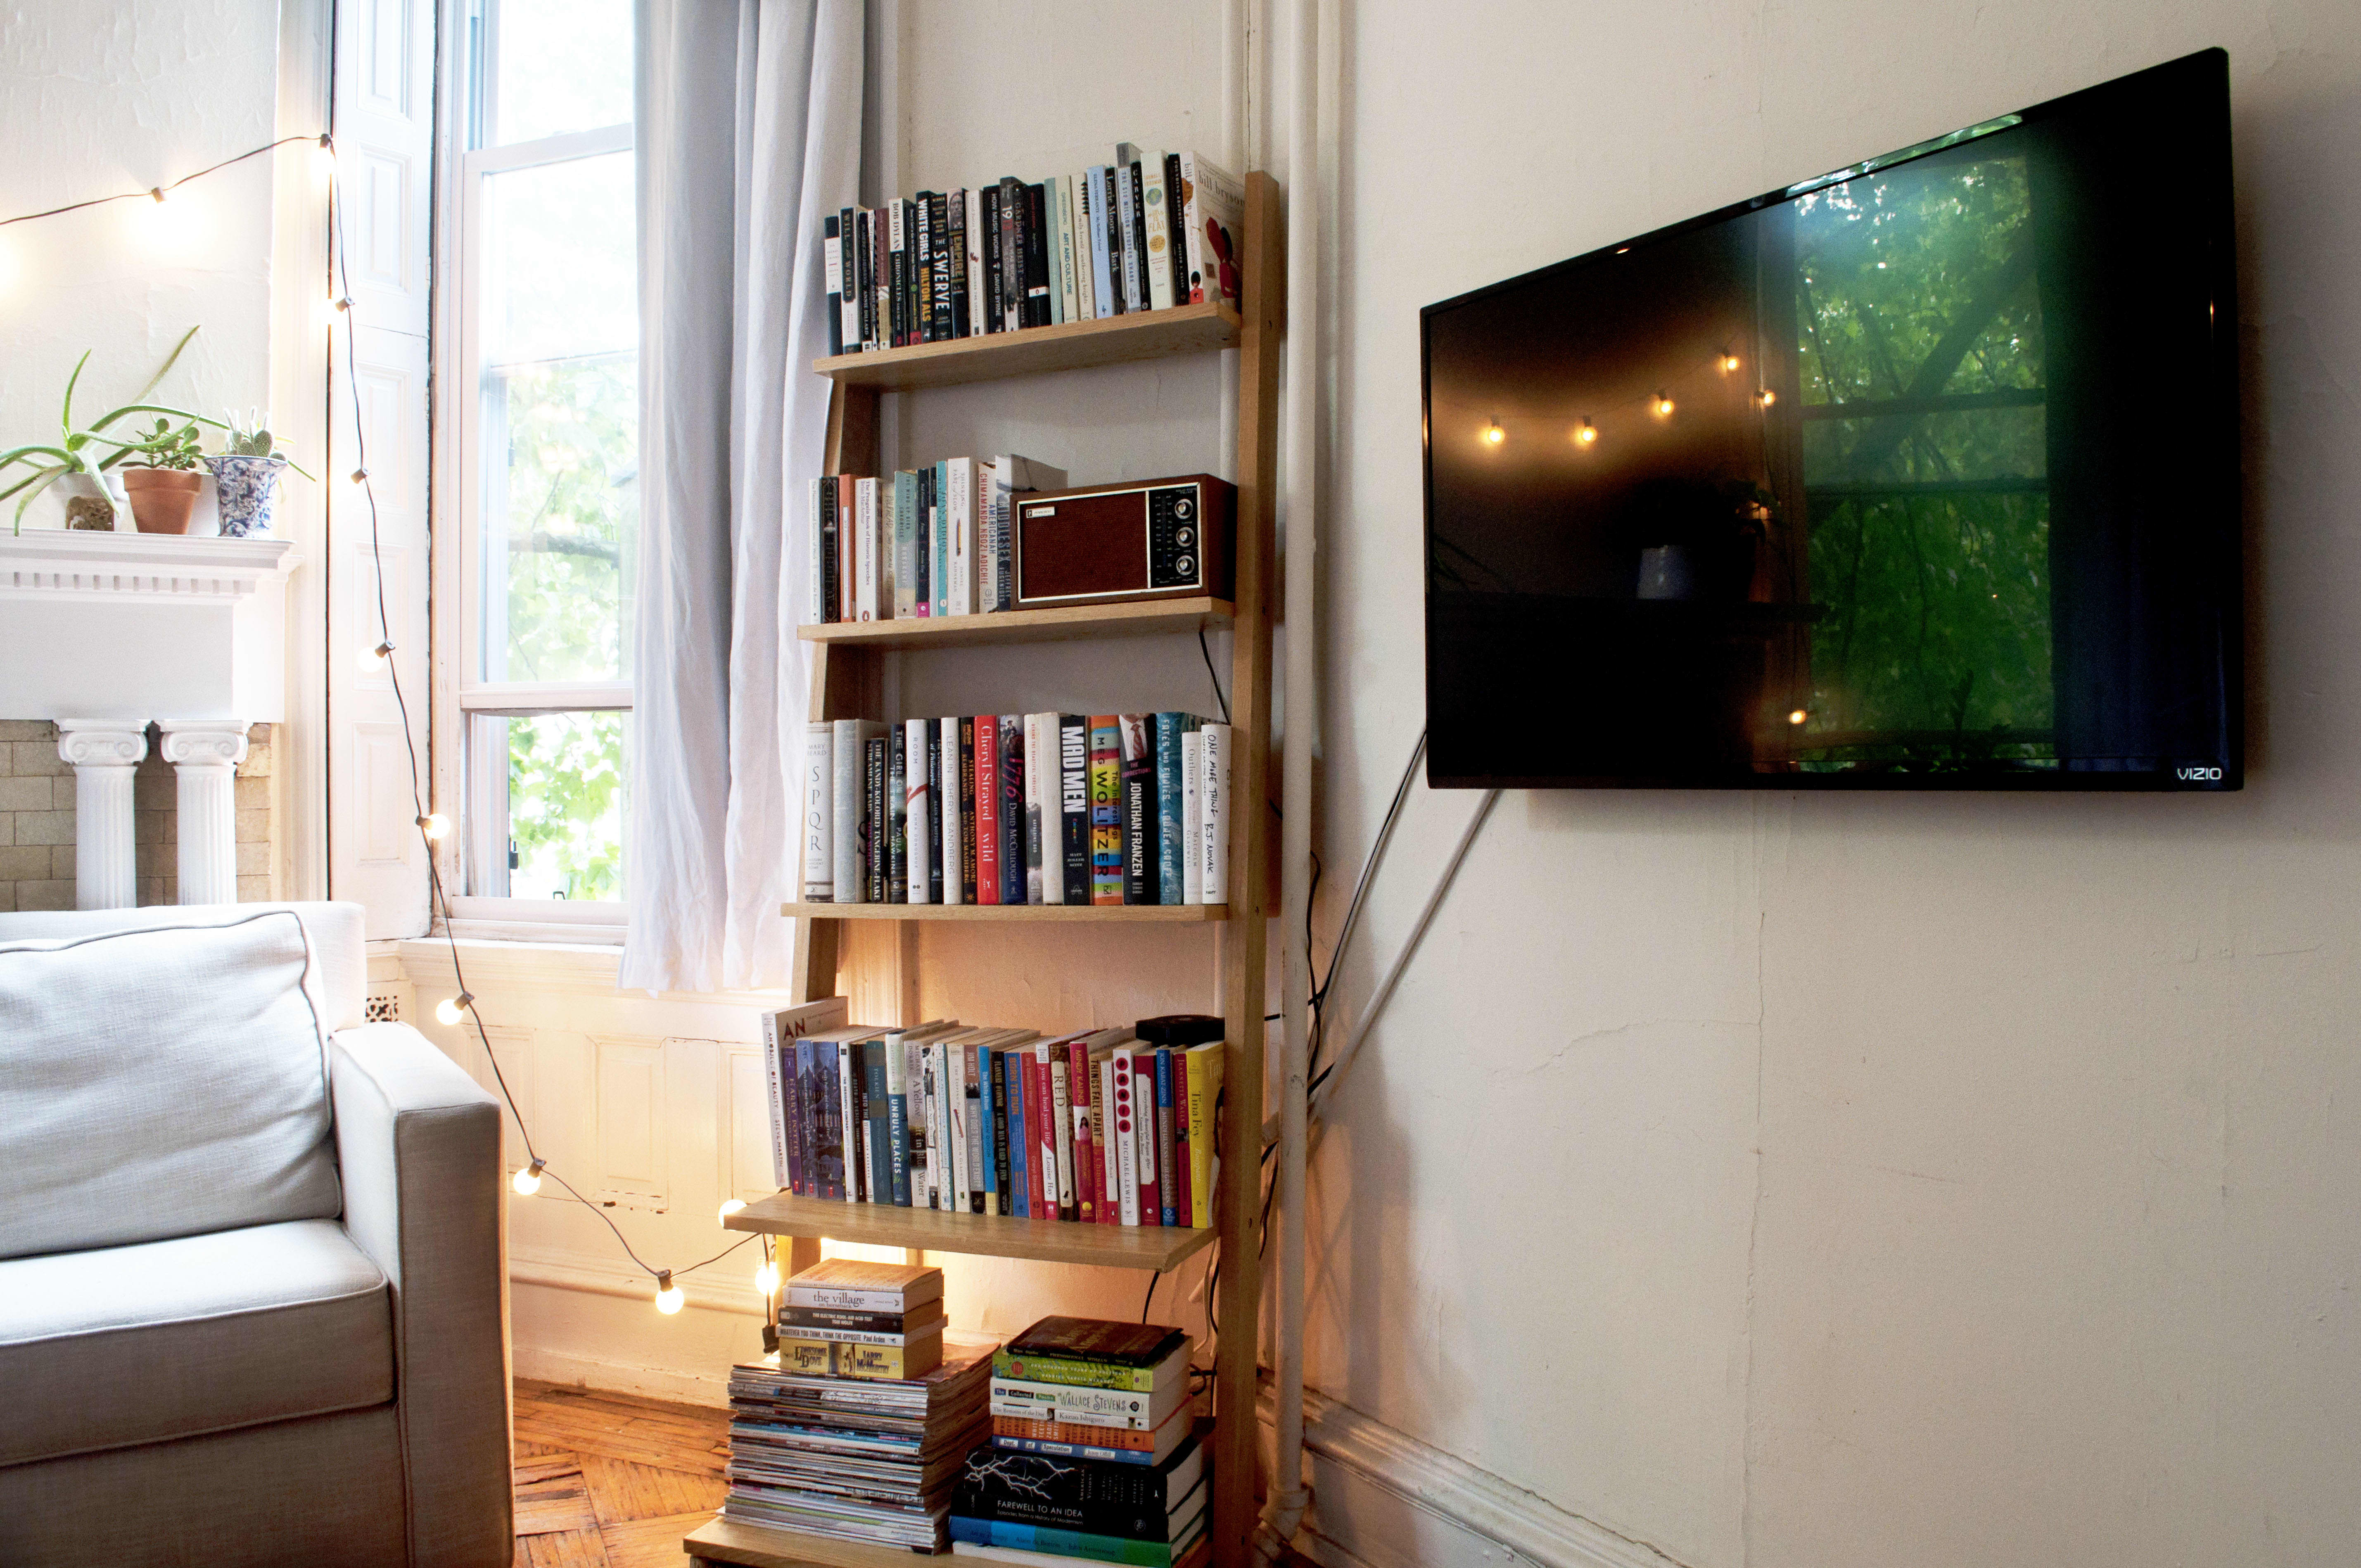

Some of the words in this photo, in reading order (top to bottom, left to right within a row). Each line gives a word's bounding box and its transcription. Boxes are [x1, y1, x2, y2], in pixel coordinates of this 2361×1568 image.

[1106, 176, 1114, 203] Lorrie
[918, 199, 929, 232] WHITE
[1003, 206, 1013, 231] 1913
[920, 233, 929, 261] GIRLS
[954, 235, 963, 277] EMPIRE
[921, 268, 929, 302] HILTON
[934, 251, 949, 310] SWERVE
[922, 304, 931, 322] ALS
[979, 726, 992, 767] Cheryl
[1062, 726, 1084, 768] MAD
[1162, 719, 1170, 747] FATES
[1208, 734, 1217, 756] ONE
[947, 764, 953, 773] IN
[1002, 758, 1023, 803] 1776
[1187, 749, 1196, 785] Outliers
[2177, 767, 2222, 780] VIZIO
[979, 773, 993, 821] Strayed
[1063, 771, 1086, 813] MEN
[1162, 767, 1170, 800] FURIES
[1130, 782, 1142, 830] JONATHAN
[1096, 771, 1109, 876] WOLITZER
[982, 833, 993, 862] wild
[1132, 832, 1143, 876] FRANZEN
[1206, 844, 1214, 874] NOVAK
[784, 1018, 805, 1040] AN
[1008, 1057, 1018, 1082] BORN
[1091, 1060, 1099, 1089] THINGS
[1010, 1084, 1018, 1094] TO
[1054, 1075, 1065, 1107] RED
[1077, 1076, 1085, 1105] KALING
[1092, 1091, 1100, 1111] FALL
[1011, 1096, 1019, 1115] RUN
[1191, 1091, 1201, 1116] Tina
[1093, 1113, 1102, 1138] APART
[1189, 1119, 1202, 1136] Fey
[892, 1140, 901, 1174] PLACES
[1045, 1157, 1054, 1181] Louise
[814, 1290, 829, 1302] the
[833, 1292, 865, 1307] village
[823, 1331, 834, 1339] THINK
[842, 1333, 861, 1341] OPPOSITE
[1058, 1391, 1090, 1407] WALLACE
[1093, 1395, 1127, 1411] STEVENS
[1059, 1413, 1079, 1421] Kazuo
[997, 1500, 1035, 1512] FAREWELL
[1037, 1504, 1048, 1513] TO
[1050, 1507, 1062, 1516] AN
[1065, 1509, 1083, 1518] IDEA
